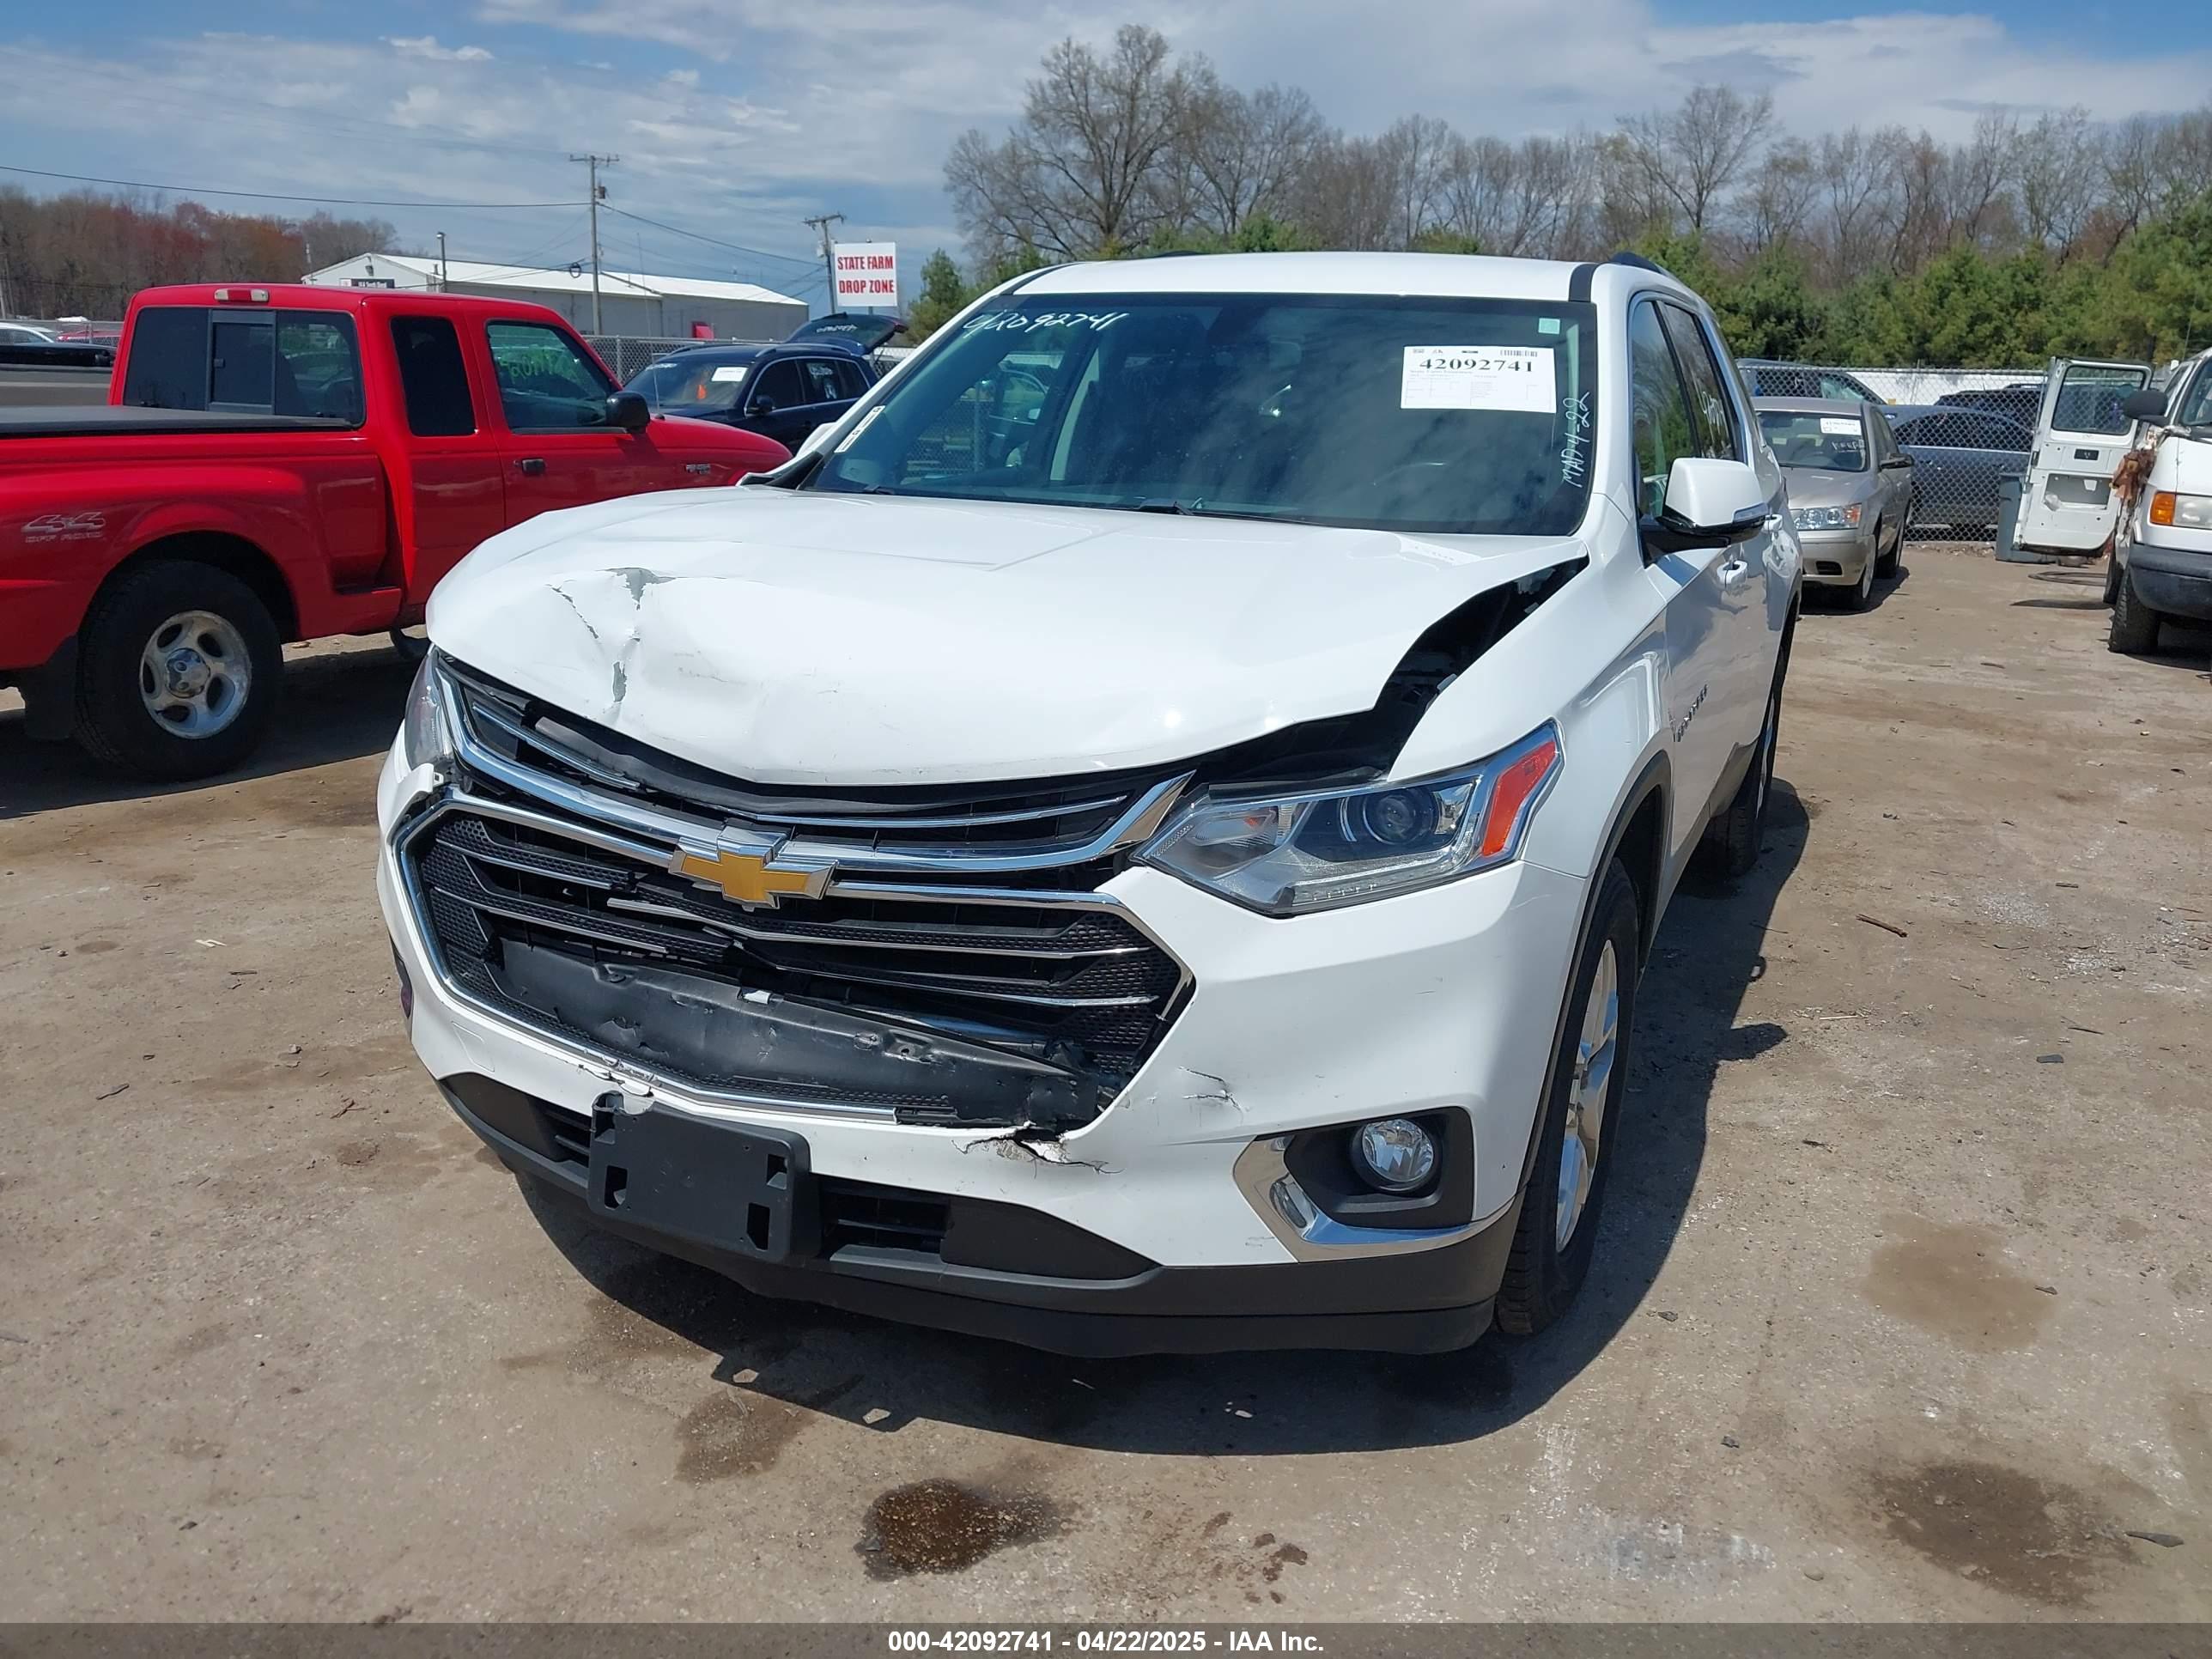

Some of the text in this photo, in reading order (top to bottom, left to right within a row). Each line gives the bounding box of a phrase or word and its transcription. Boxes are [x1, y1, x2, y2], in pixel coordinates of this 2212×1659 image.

[837, 255, 894, 270] STATE FARM
[839, 279, 895, 294] DROP ZONE
[963, 310, 1130, 339] 42092741
[1419, 357, 1533, 373] 42092741
